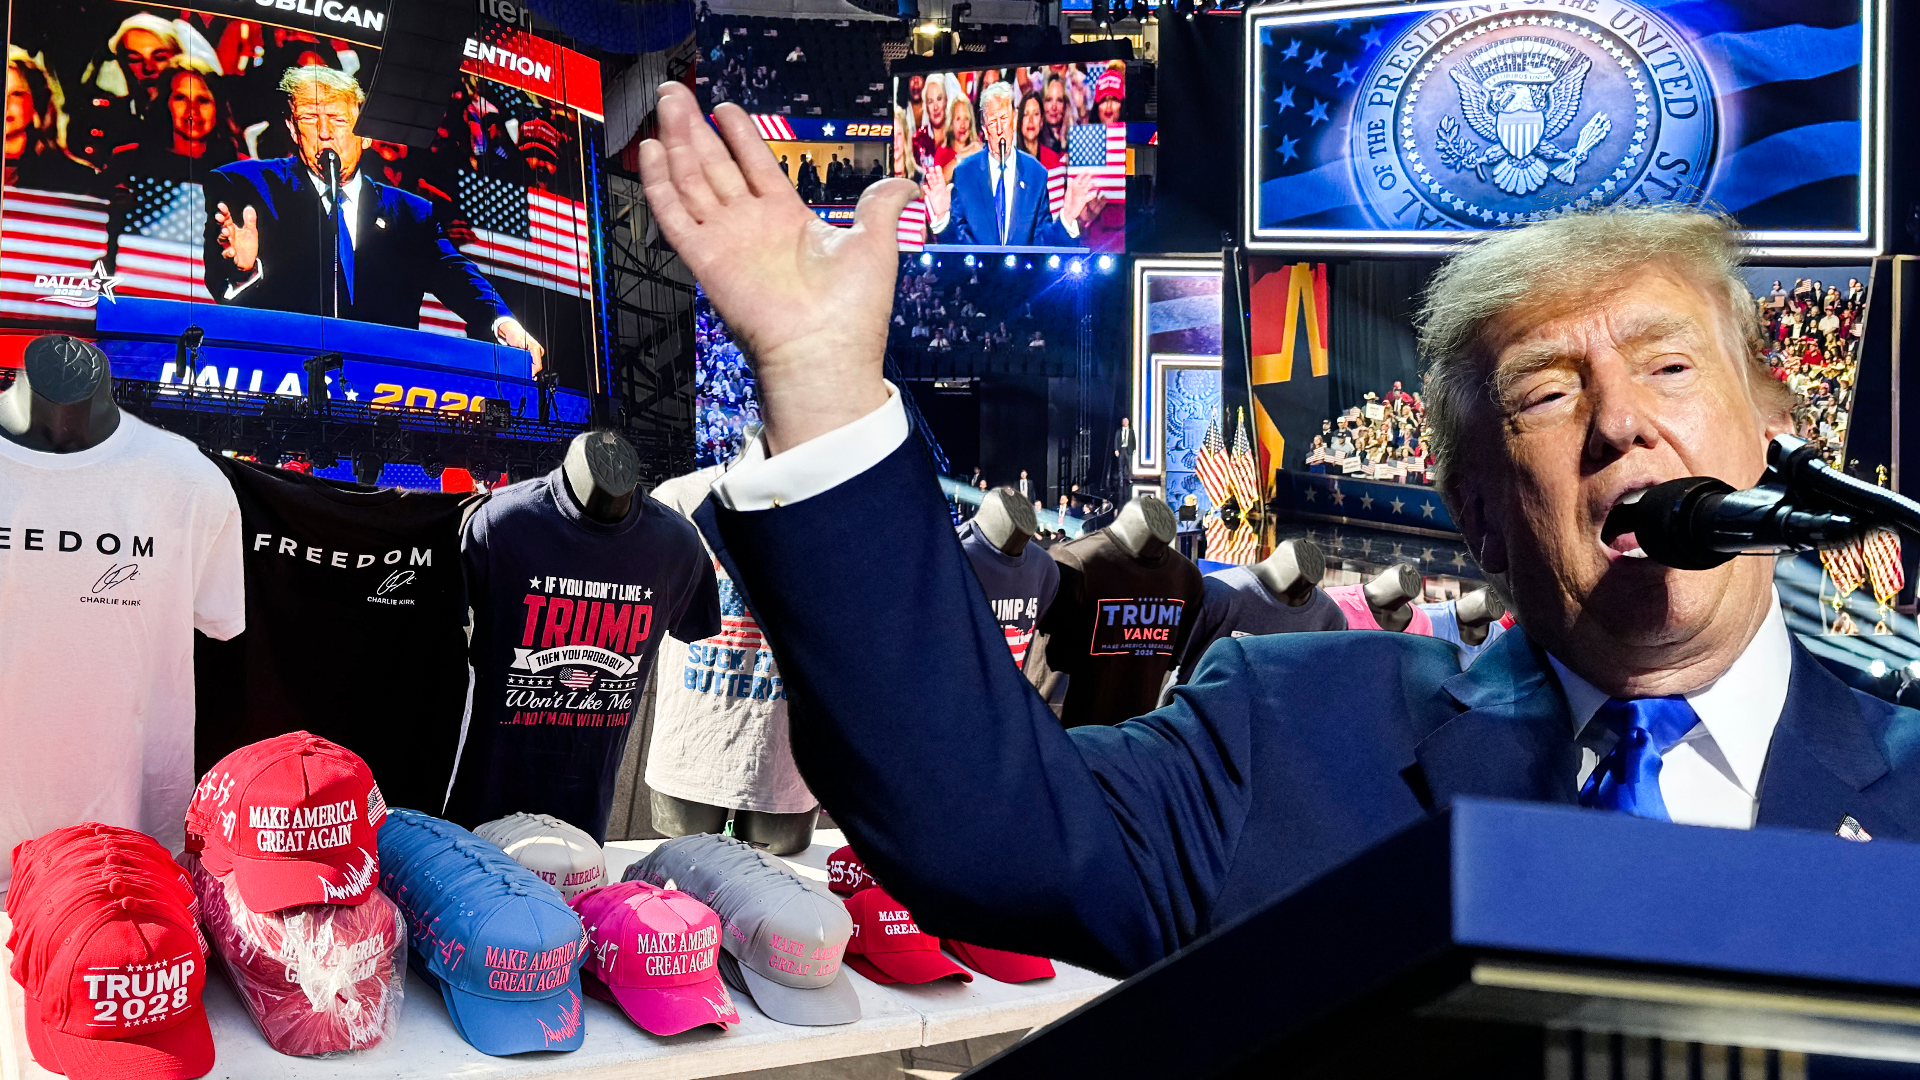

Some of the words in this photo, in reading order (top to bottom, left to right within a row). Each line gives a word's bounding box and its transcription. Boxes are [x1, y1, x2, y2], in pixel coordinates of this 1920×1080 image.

[463, 37, 552, 83] ENTION
[1610, 7, 1698, 119] UNITED
[845, 123, 893, 136] 2026
[1367, 118, 1387, 160] THE
[1373, 164, 1397, 190] OF
[34, 275, 101, 290] DALLAS
[158, 362, 332, 400] DALLA
[253, 533, 432, 569] FREEDOM
[80, 596, 119, 605] CHARLIE
[122, 599, 141, 607] KIRK
[367, 596, 397, 605] CHARLIE
[545, 576, 556, 593] IF
[559, 578, 583, 597] YOU
[584, 581, 618, 600] DON'T
[619, 584, 642, 602] LIKE
[1025, 597, 1038, 619] 45
[521, 594, 653, 654] TRUMP
[1124, 628, 1170, 640] VANCE
[536, 654, 560, 667] THEN
[562, 650, 581, 661] YOU
[581, 650, 625, 670] PROBABLY
[688, 643, 747, 670] SUCK
[505, 690, 564, 709] Won't
[565, 692, 603, 710] Like
[607, 693, 632, 711] Me
[557, 713, 573, 726] OK
[576, 713, 603, 727] WITH
[606, 712, 630, 727] THAT
[249, 805, 290, 829] MAKE
[292, 799, 358, 829] AMERICA
[257, 829, 305, 852] GREAT
[307, 823, 353, 851] AGAIN
[563, 865, 601, 886] AMERICA
[878, 910, 909, 921] MAKE
[637, 932, 676, 954] MAKE
[676, 925, 718, 953] AMERICA
[769, 933, 805, 957] MAKE
[485, 945, 528, 971] MAKE
[645, 954, 688, 976] GREAT
[688, 947, 715, 973] AGAIN
[769, 954, 811, 976] GREAT
[84, 959, 195, 1000] TRUMP
[488, 970, 537, 992] GREAT
[536, 963, 571, 992] AGAIN
[94, 986, 188, 1021] 2028
